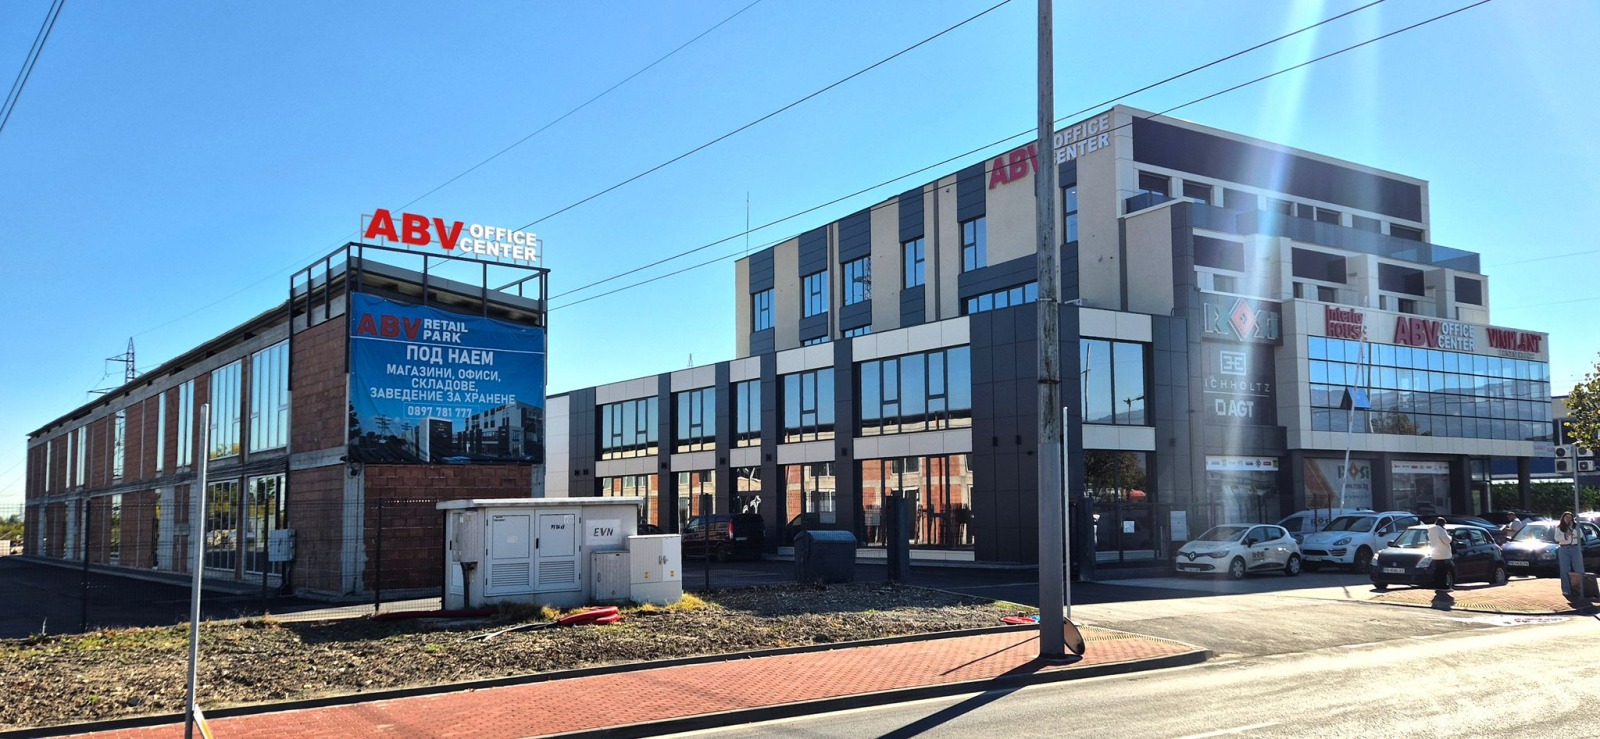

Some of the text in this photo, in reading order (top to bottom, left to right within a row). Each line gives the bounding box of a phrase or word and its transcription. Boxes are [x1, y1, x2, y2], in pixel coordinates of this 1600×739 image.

[1053, 113, 1110, 149] OFFICE
[364, 208, 537, 250] ABV OFFICE
[459, 237, 537, 262] CENTER
[1325, 305, 1364, 324] Interio
[357, 313, 469, 340] ABV RETAIL
[423, 329, 461, 343] PARK
[1394, 316, 1476, 348] ABV OFFICE
[1438, 335, 1476, 352] CENTER
[406, 345, 494, 366] ПОД НАЕМ
[386, 363, 501, 382] МАГАЗИНИ, ОФИСИ,
[411, 378, 479, 393] СКЛАДОВЕ,
[370, 387, 516, 405] ЗАВЕДЕНИЕ ЗА ХРАНЕНЕ
[407, 405, 472, 418] 0897 781 777
[1228, 400, 1255, 417] AGT
[593, 527, 614, 537] EVN
